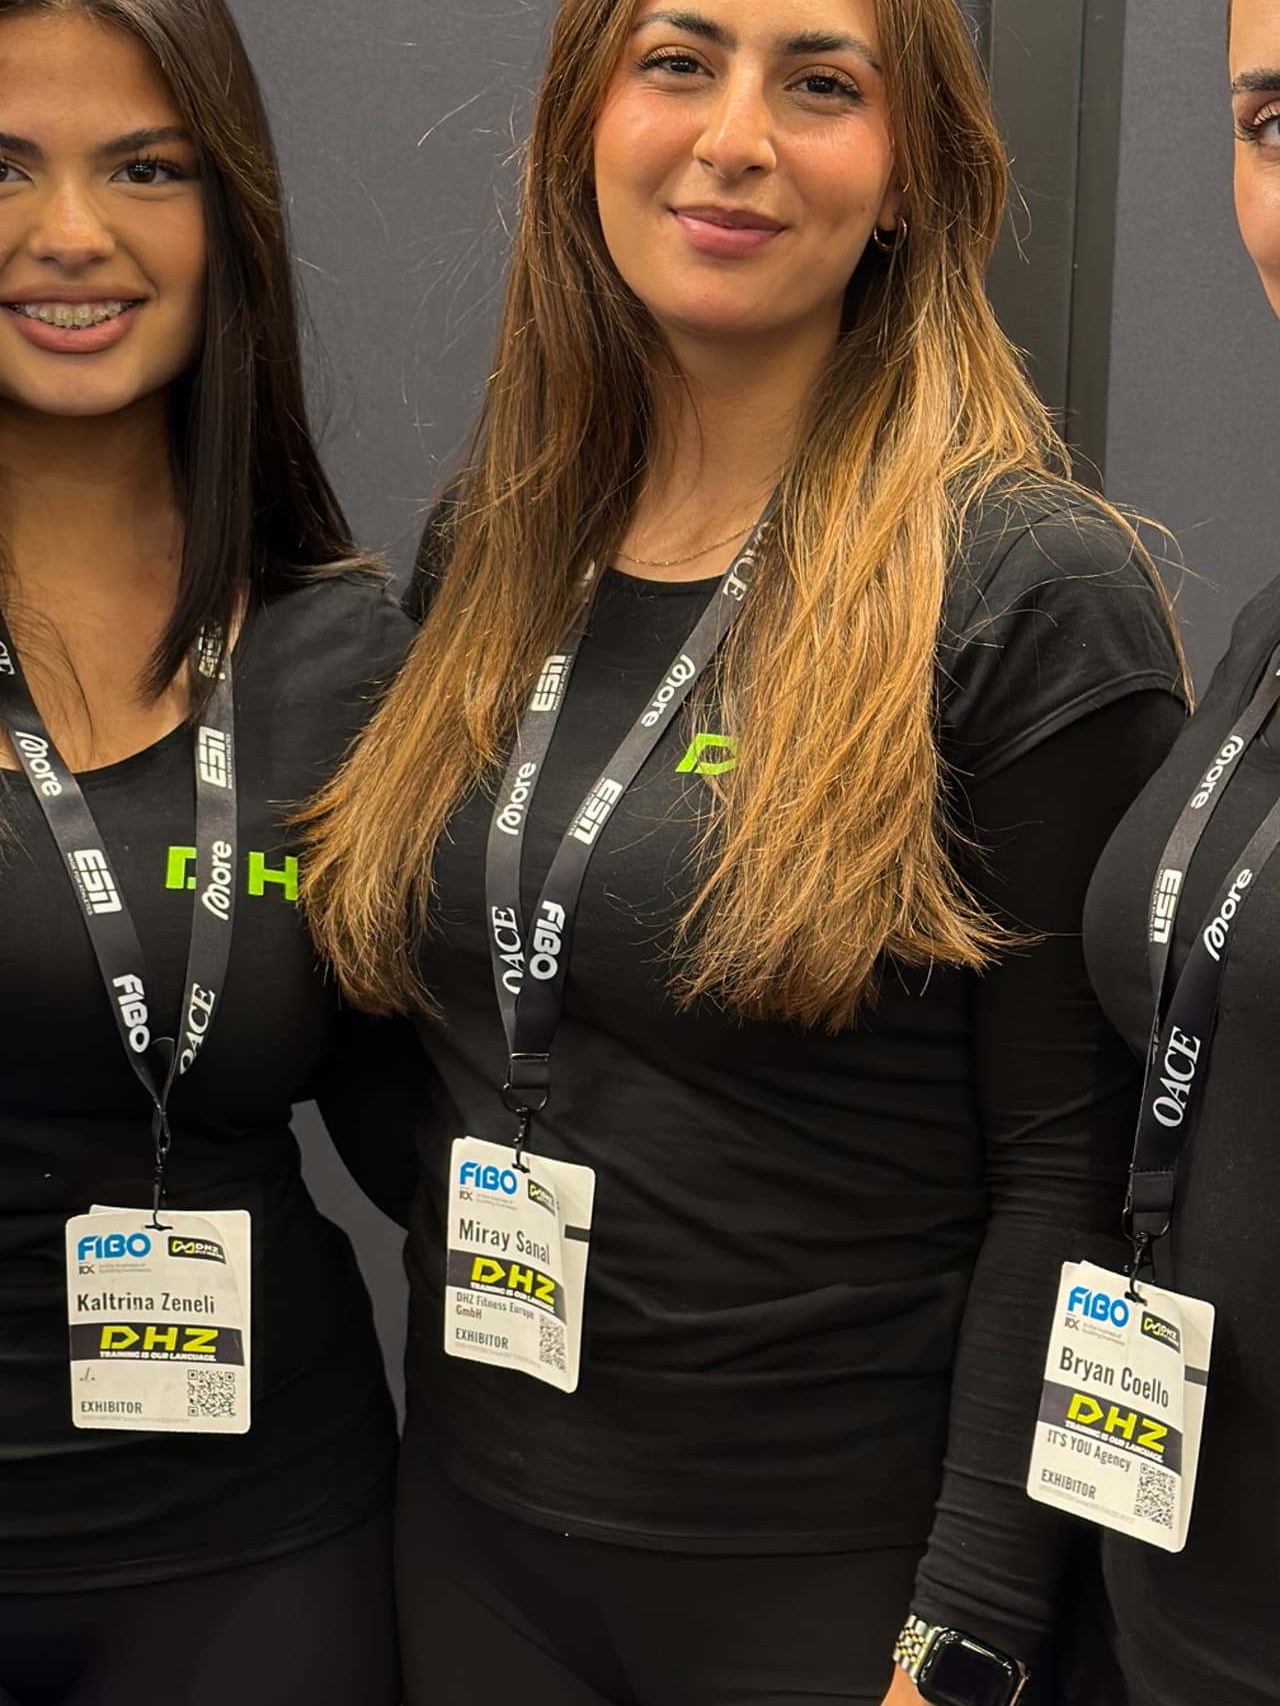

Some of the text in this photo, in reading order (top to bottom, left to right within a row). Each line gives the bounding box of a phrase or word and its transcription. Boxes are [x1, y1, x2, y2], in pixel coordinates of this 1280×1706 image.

[530, 654, 566, 711] ESN
[198, 725, 226, 788] ESN
[573, 778, 623, 845] ESN
[73, 849, 122, 914] ESN
[166, 845, 298, 901] DH
[1153, 869, 1182, 944] ESN
[491, 906, 524, 995] OACE
[530, 899, 567, 981] FIBO
[112, 973, 151, 1053] FIBO
[179, 983, 216, 1075] OACE
[1153, 1025, 1202, 1129] OACE
[459, 1162, 517, 1195] FIBO
[77, 1233, 152, 1261] FIBO
[459, 1218, 550, 1265] Miray Sanal
[77, 1293, 215, 1314] Kaltrina Zeneli
[471, 1256, 555, 1305] DHZ
[476, 1295, 507, 1312] Fitness
[1067, 1285, 1130, 1328] FIBO
[455, 1328, 509, 1349] EXHIBITOR
[456, 1305, 482, 1320] GmbH
[99, 1325, 219, 1353] DHZ
[1060, 1346, 1169, 1408] Bryan Coello
[81, 1401, 142, 1414] EXHIBITOR
[1066, 1393, 1168, 1453] DHZ
[1070, 1435, 1091, 1456] YOU
[1093, 1445, 1131, 1472] Agency
[1041, 1469, 1096, 1499] EXHIBITOR
